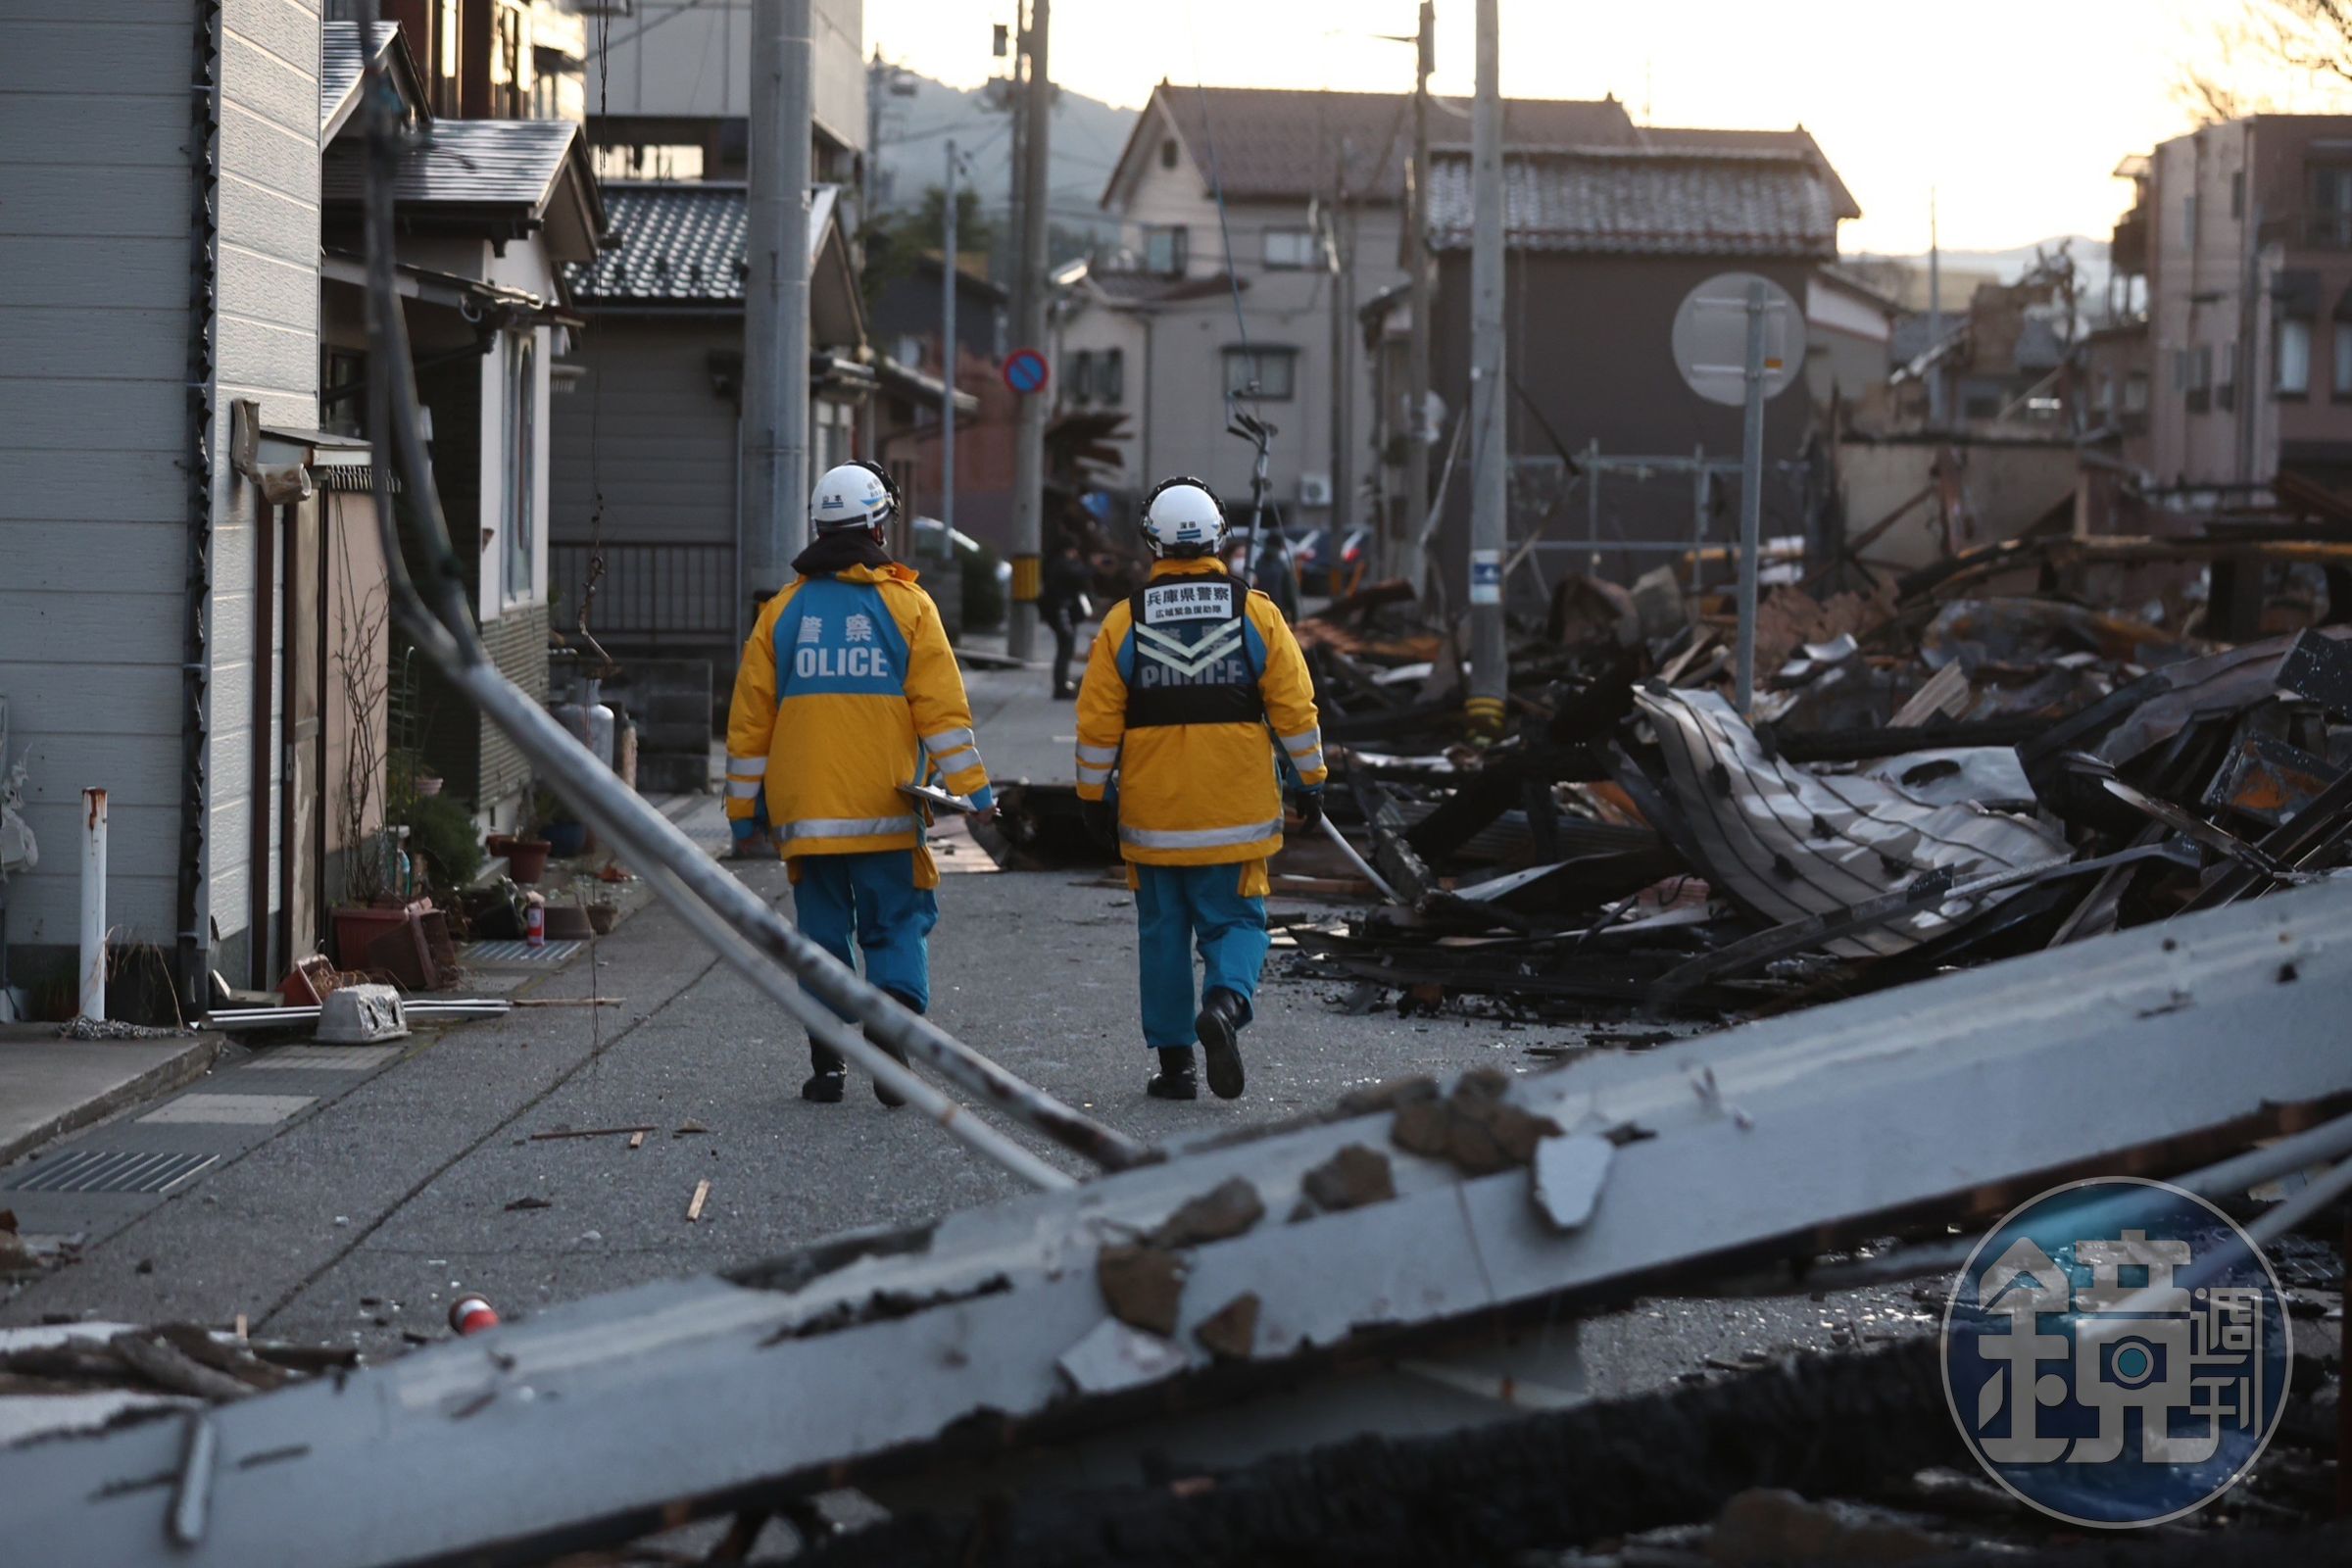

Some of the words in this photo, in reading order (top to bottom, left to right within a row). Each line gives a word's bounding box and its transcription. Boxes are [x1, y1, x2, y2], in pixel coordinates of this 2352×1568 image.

[1148, 587, 1229, 607] 兵庫県警察
[798, 613, 872, 643] 警察
